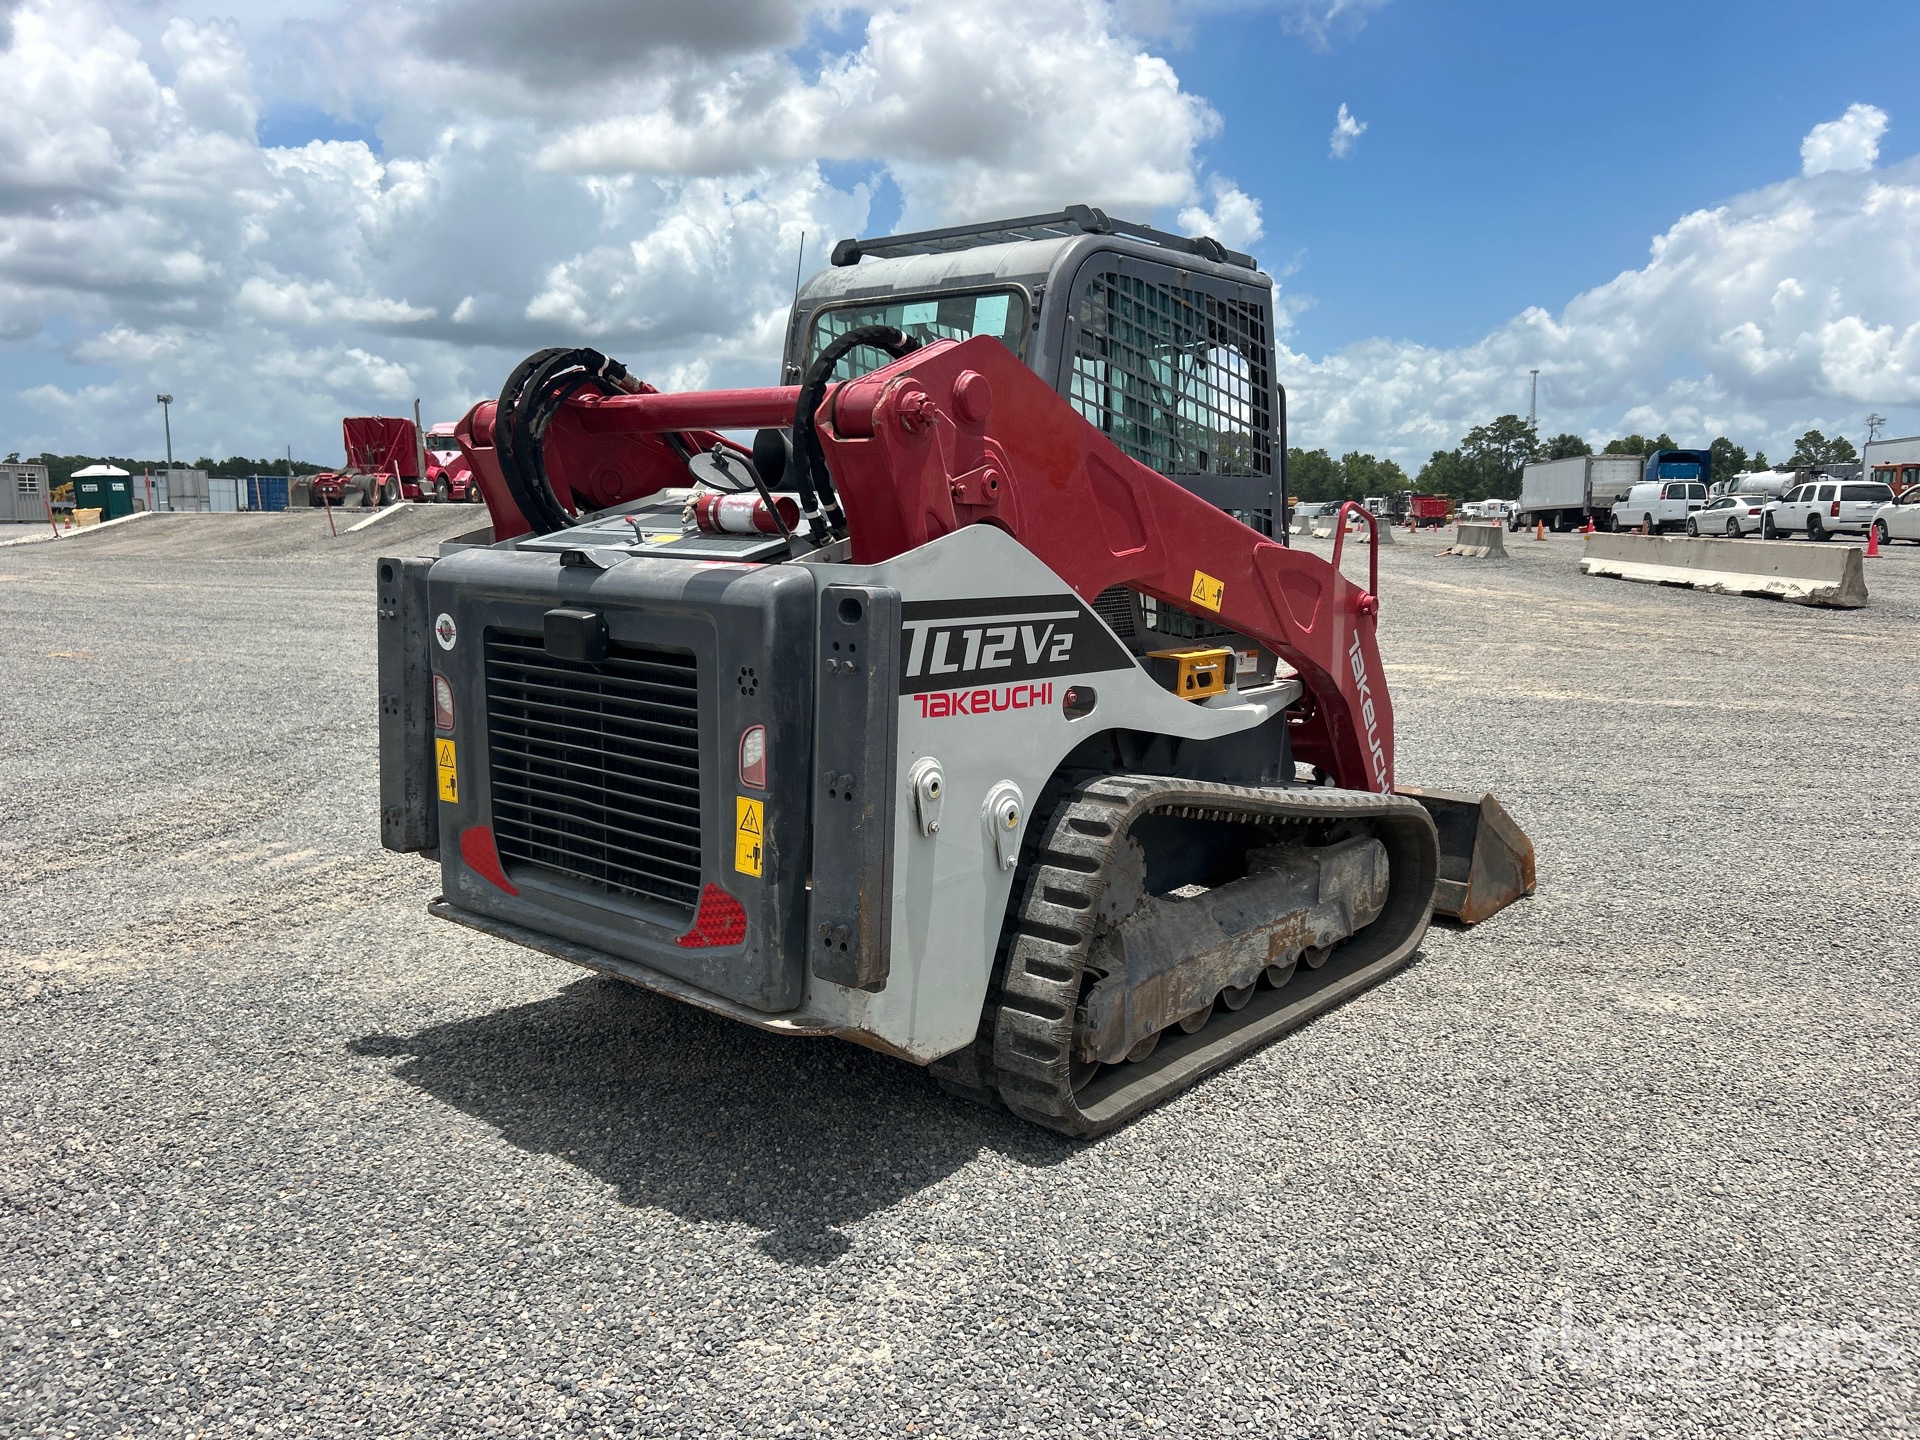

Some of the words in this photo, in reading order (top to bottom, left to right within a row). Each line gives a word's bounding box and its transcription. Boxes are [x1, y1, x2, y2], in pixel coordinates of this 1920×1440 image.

[902, 610, 1079, 677] TL12V2
[914, 682, 1052, 718] TAKEUCHI
[1349, 629, 1391, 795] TAKEUCH
